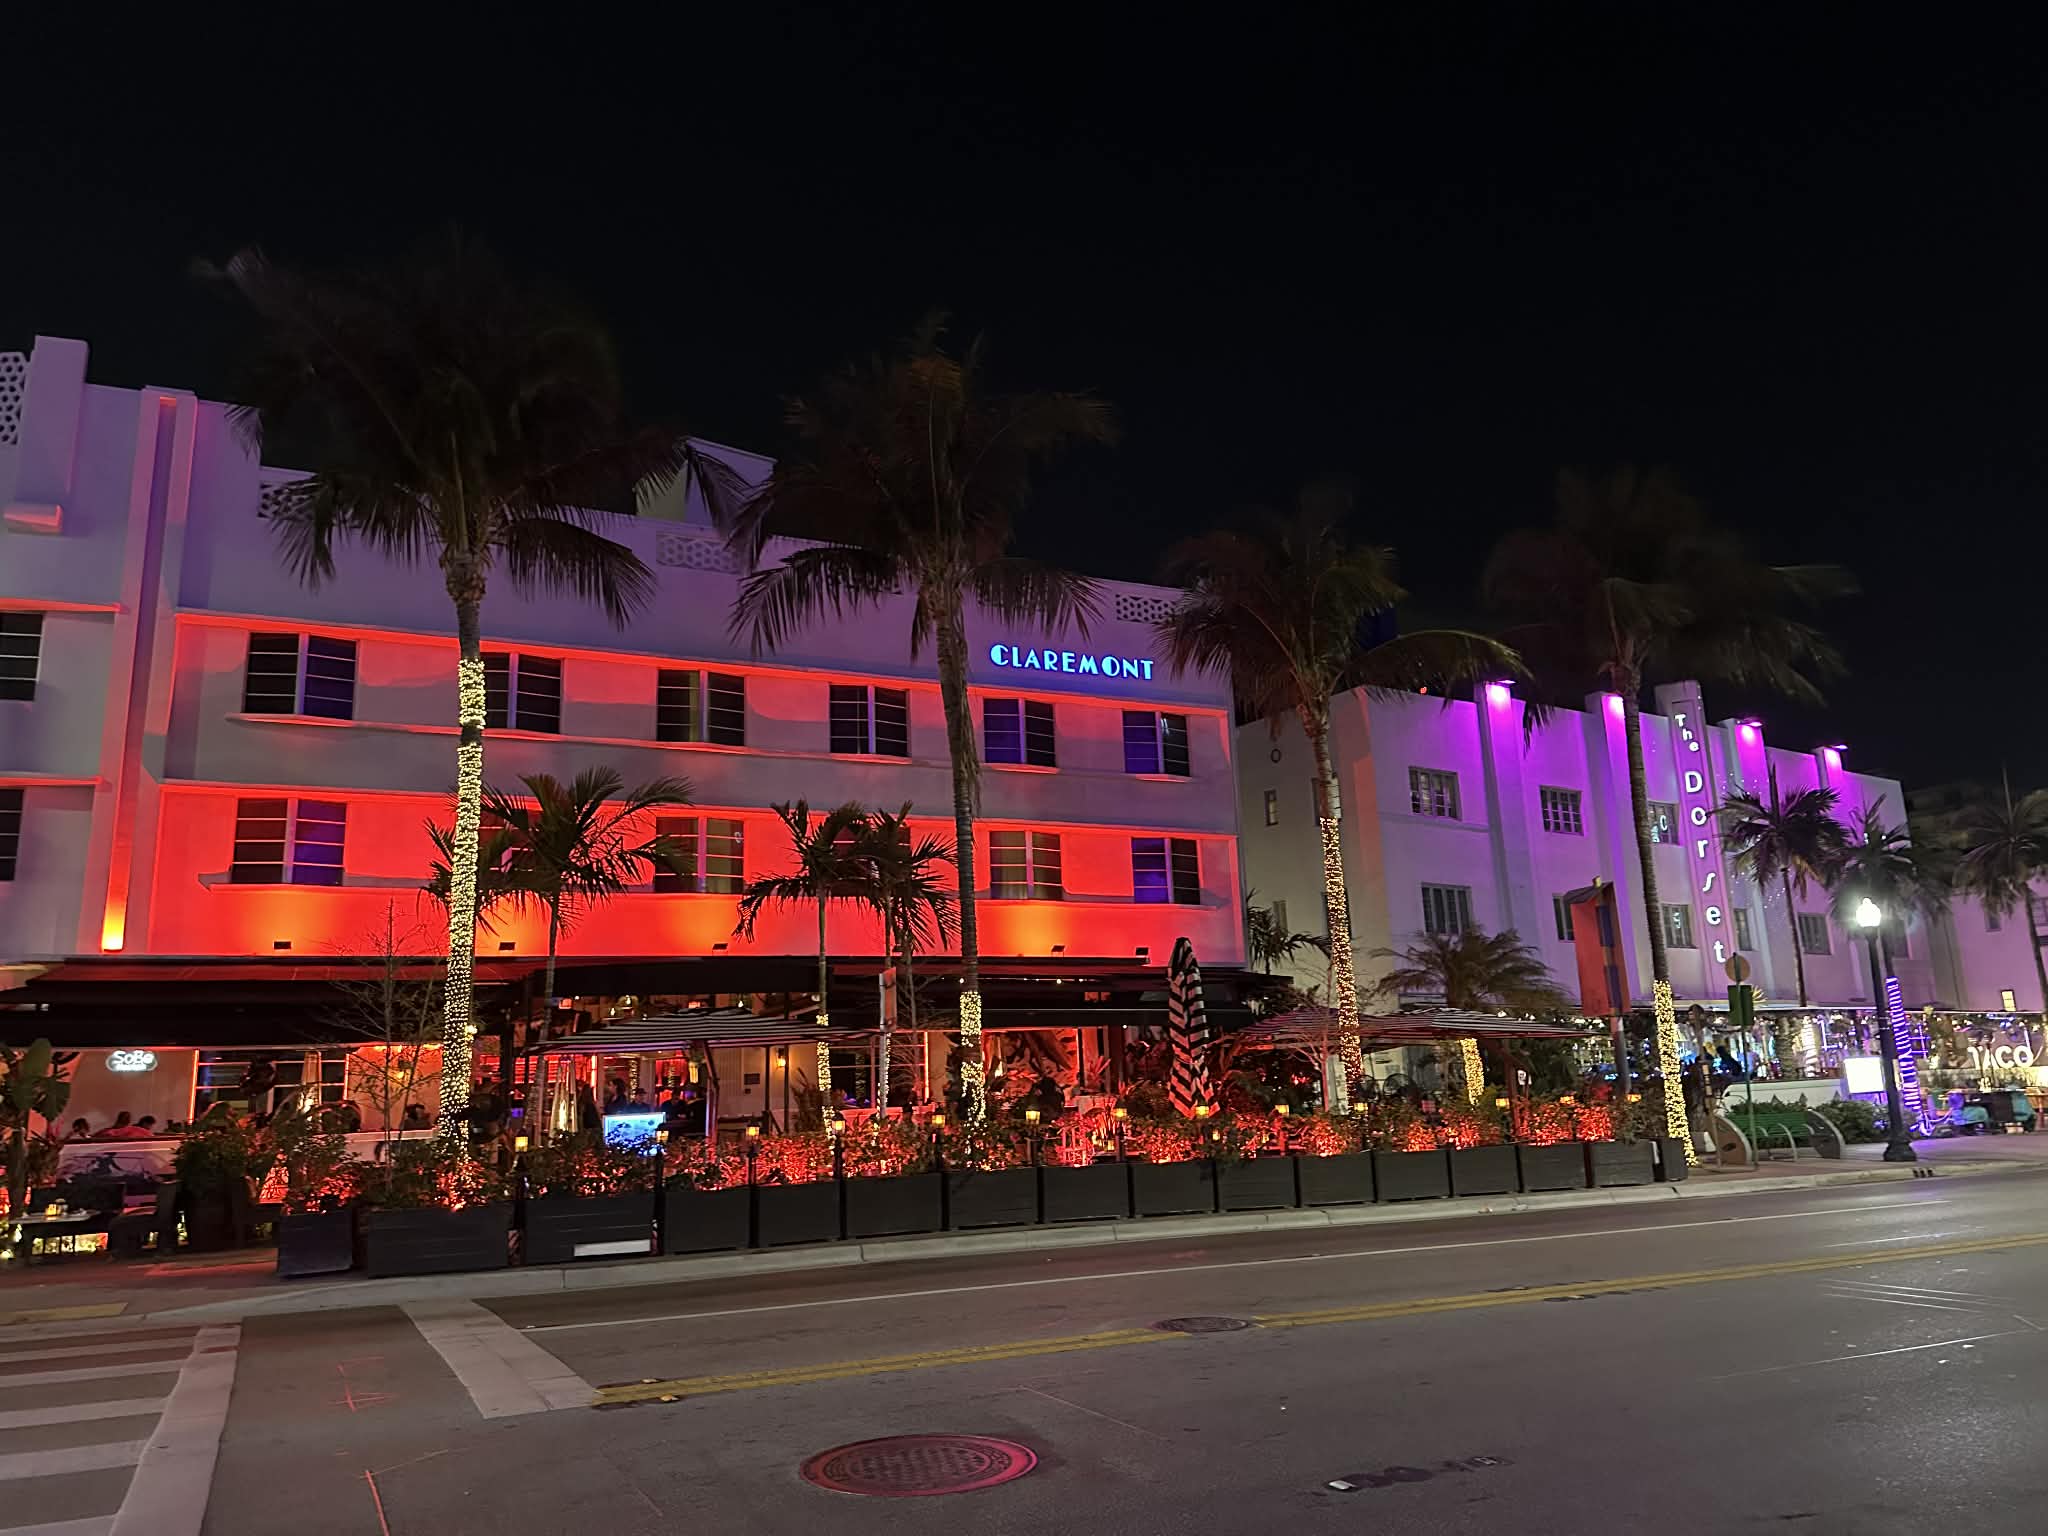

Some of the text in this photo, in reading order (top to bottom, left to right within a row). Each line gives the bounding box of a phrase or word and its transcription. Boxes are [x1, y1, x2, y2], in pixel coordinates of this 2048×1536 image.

[990, 644, 1154, 680] CLAREMONT
[1674, 713, 1727, 963] The Dorset
